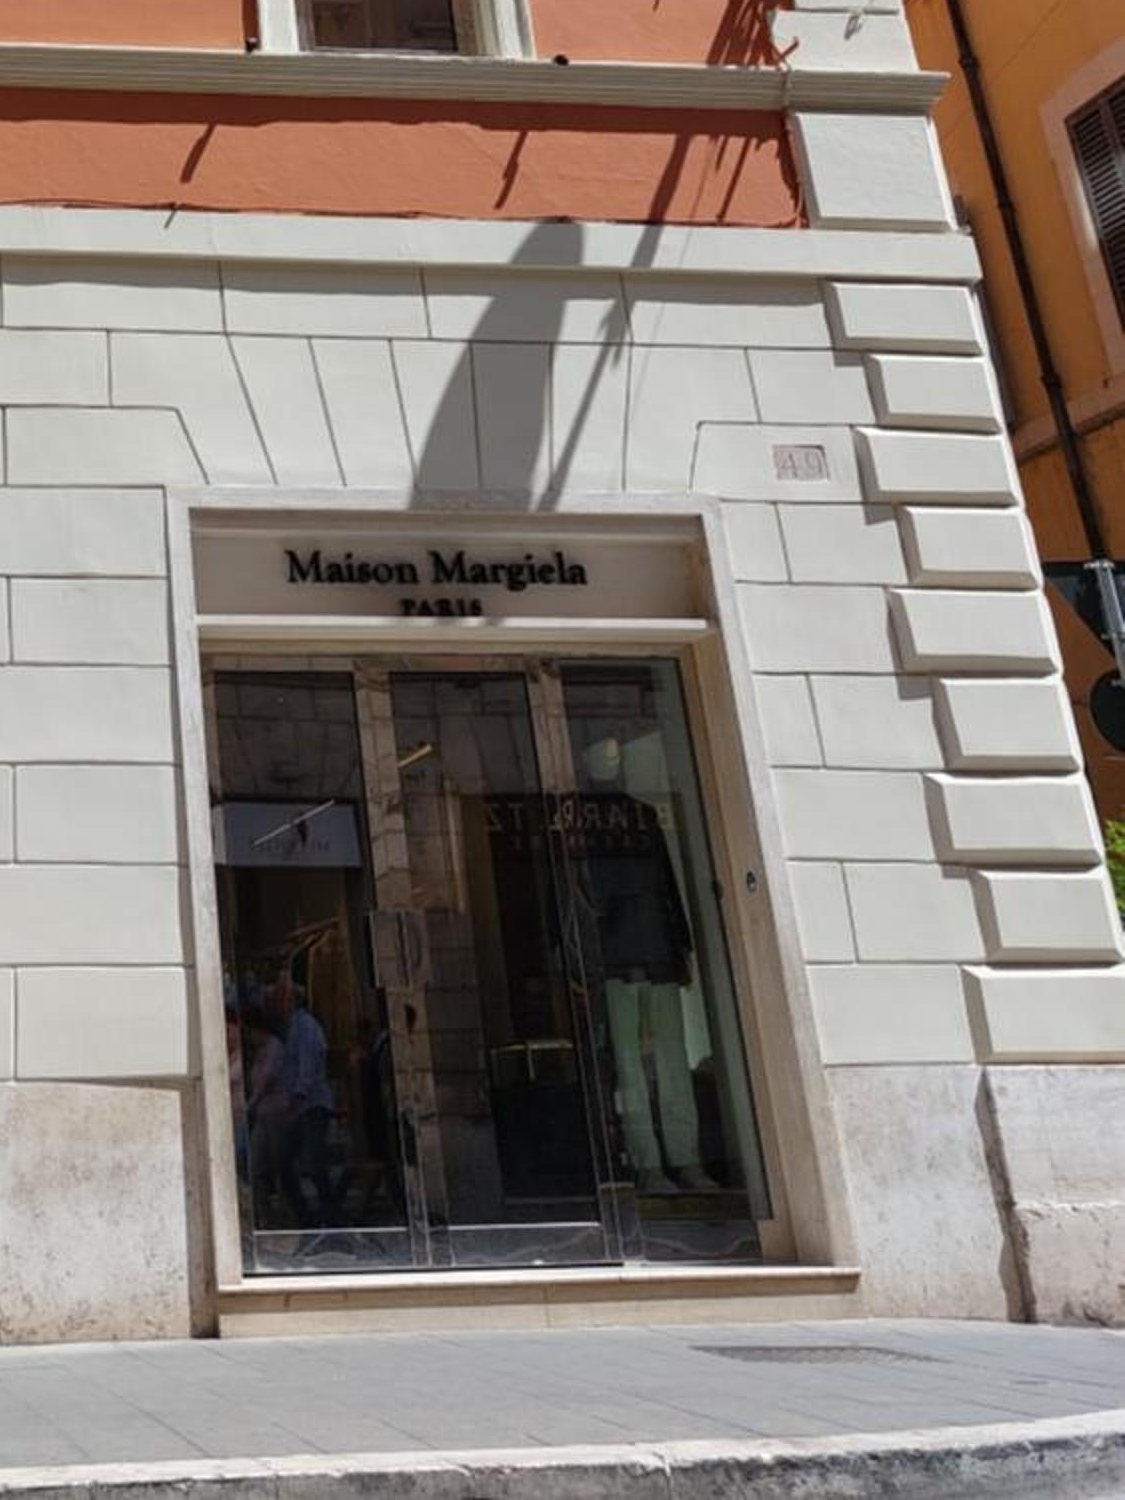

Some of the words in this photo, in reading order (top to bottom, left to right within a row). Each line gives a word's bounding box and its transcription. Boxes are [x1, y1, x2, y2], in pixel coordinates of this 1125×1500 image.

[284, 550, 420, 584] Maison
[431, 550, 588, 592] Margiela
[400, 598, 483, 617] PARIS
